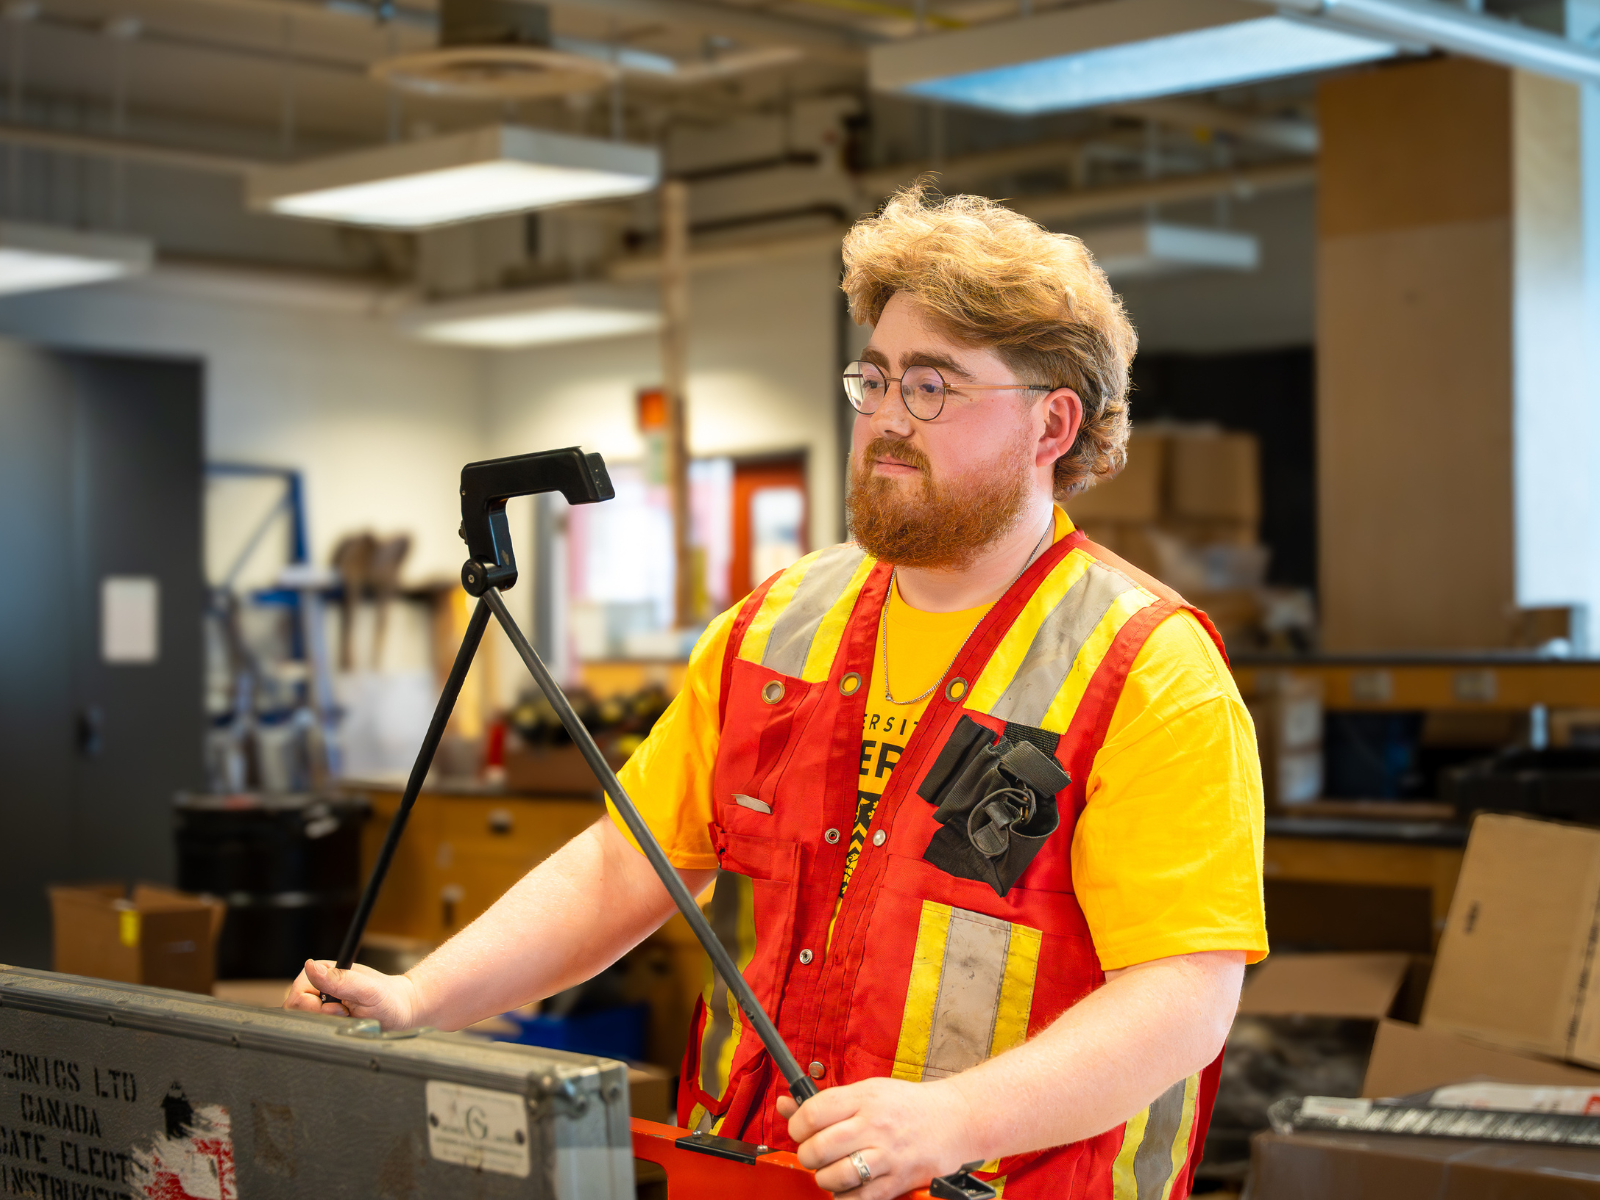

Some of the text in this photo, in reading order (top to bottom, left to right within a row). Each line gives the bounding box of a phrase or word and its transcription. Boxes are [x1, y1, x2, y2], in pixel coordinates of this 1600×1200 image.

[862, 713, 919, 736] RSI
[859, 739, 905, 779] ER
[20, 1092, 102, 1138] CANADA
[2, 1163, 132, 1200] INSTRUM
